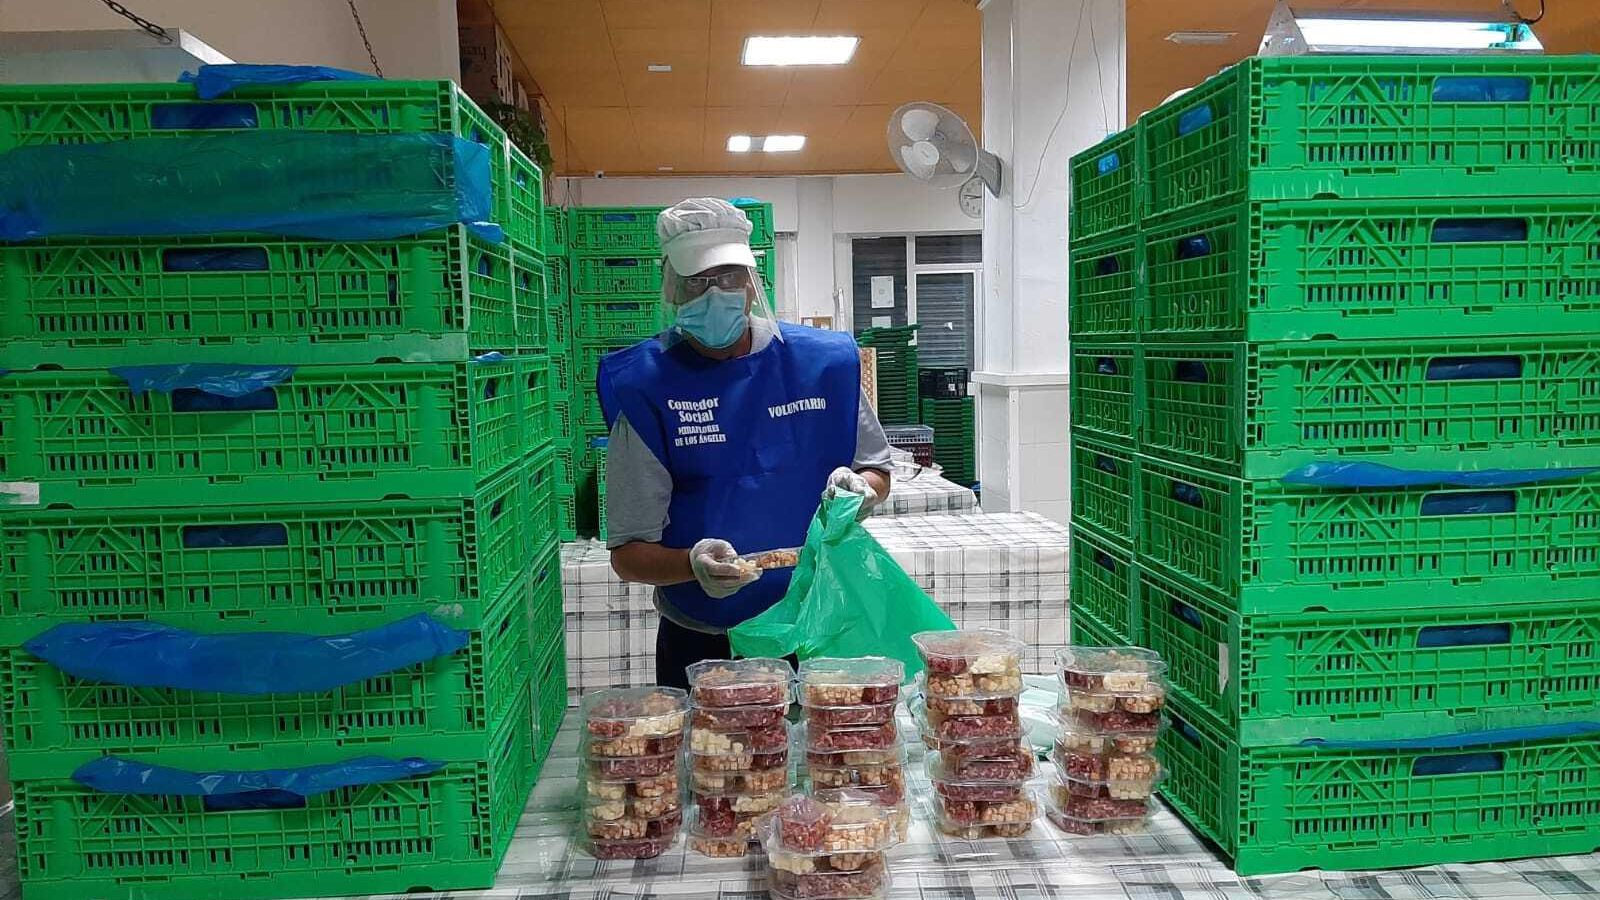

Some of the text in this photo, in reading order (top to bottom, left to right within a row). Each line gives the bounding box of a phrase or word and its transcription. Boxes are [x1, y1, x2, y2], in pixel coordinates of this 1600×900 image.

[667, 397, 719, 411] Comedor
[767, 397, 827, 419] VOLUNTARIO
[678, 409, 714, 423] Social
[677, 424, 720, 435] MIRAFLORES
[674, 433, 727, 447] DE LOS ÁNGELES
